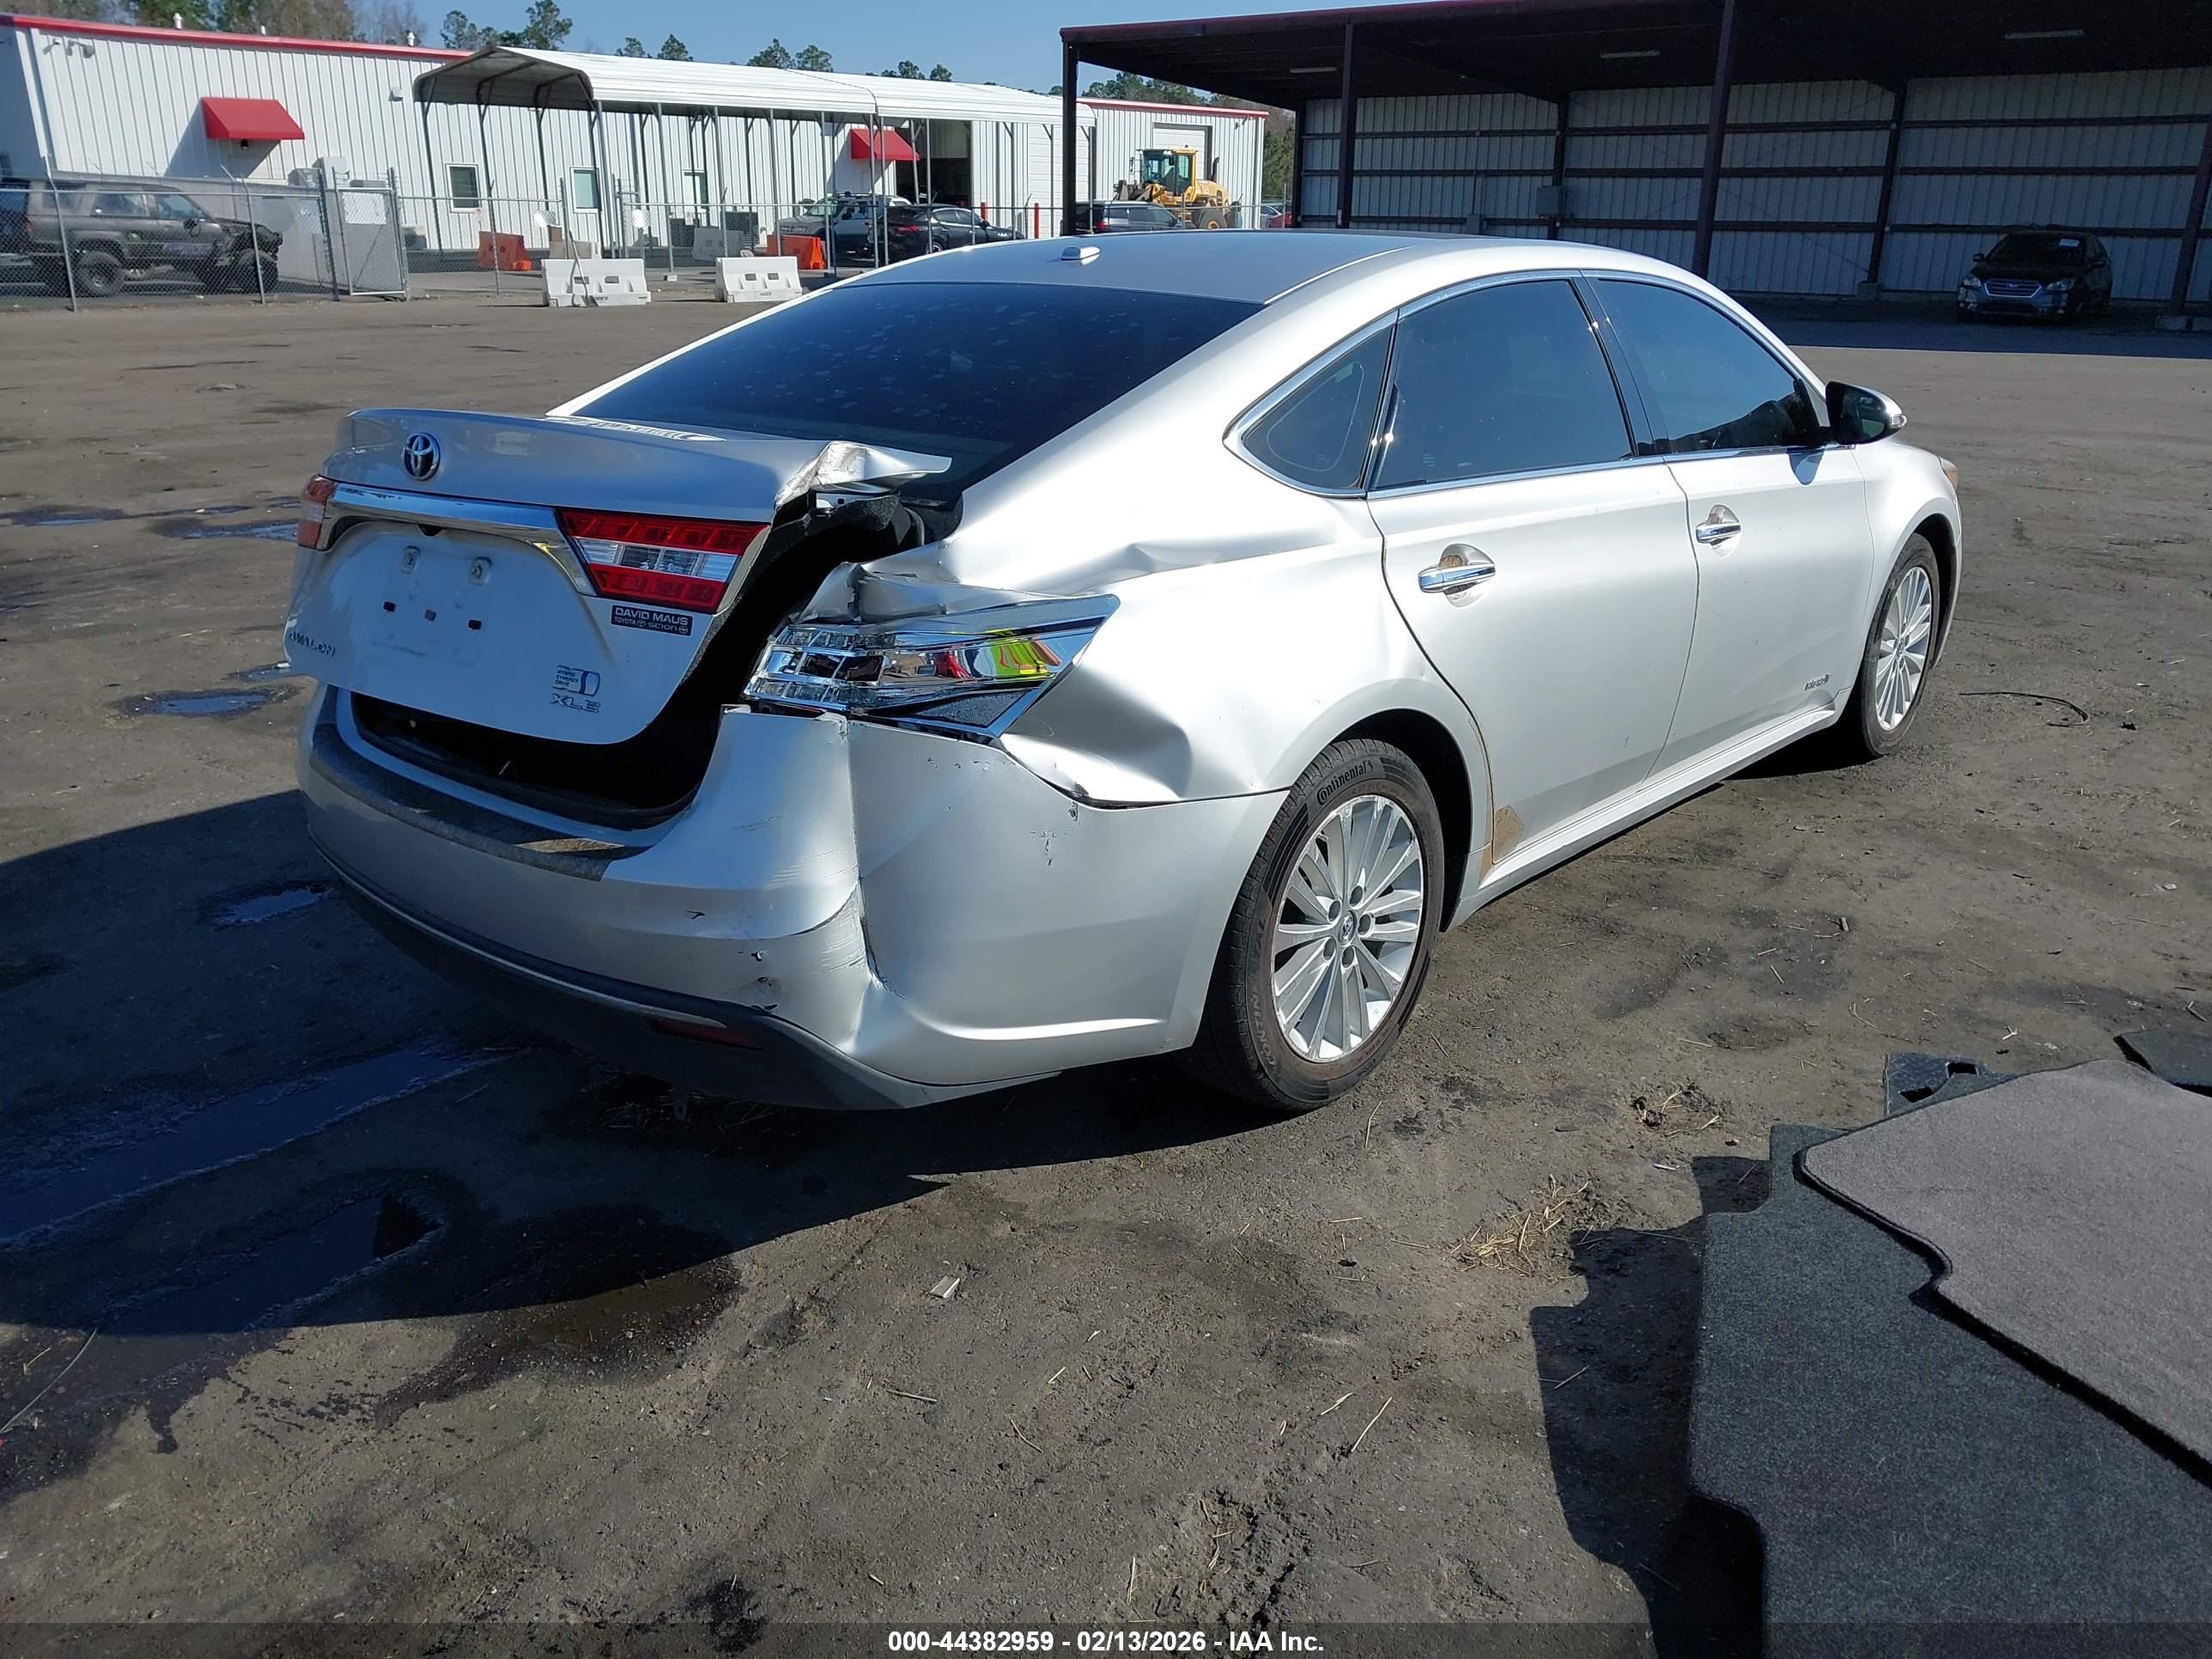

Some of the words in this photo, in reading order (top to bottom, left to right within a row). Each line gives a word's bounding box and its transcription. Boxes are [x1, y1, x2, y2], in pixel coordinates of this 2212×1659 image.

[614, 617, 636, 625] TOYOTA
[615, 607, 650, 620] DAVID
[653, 612, 689, 626] MAUS
[289, 631, 336, 658] AVALON
[550, 693, 601, 713] XLE
[1316, 760, 1367, 805] Continental
